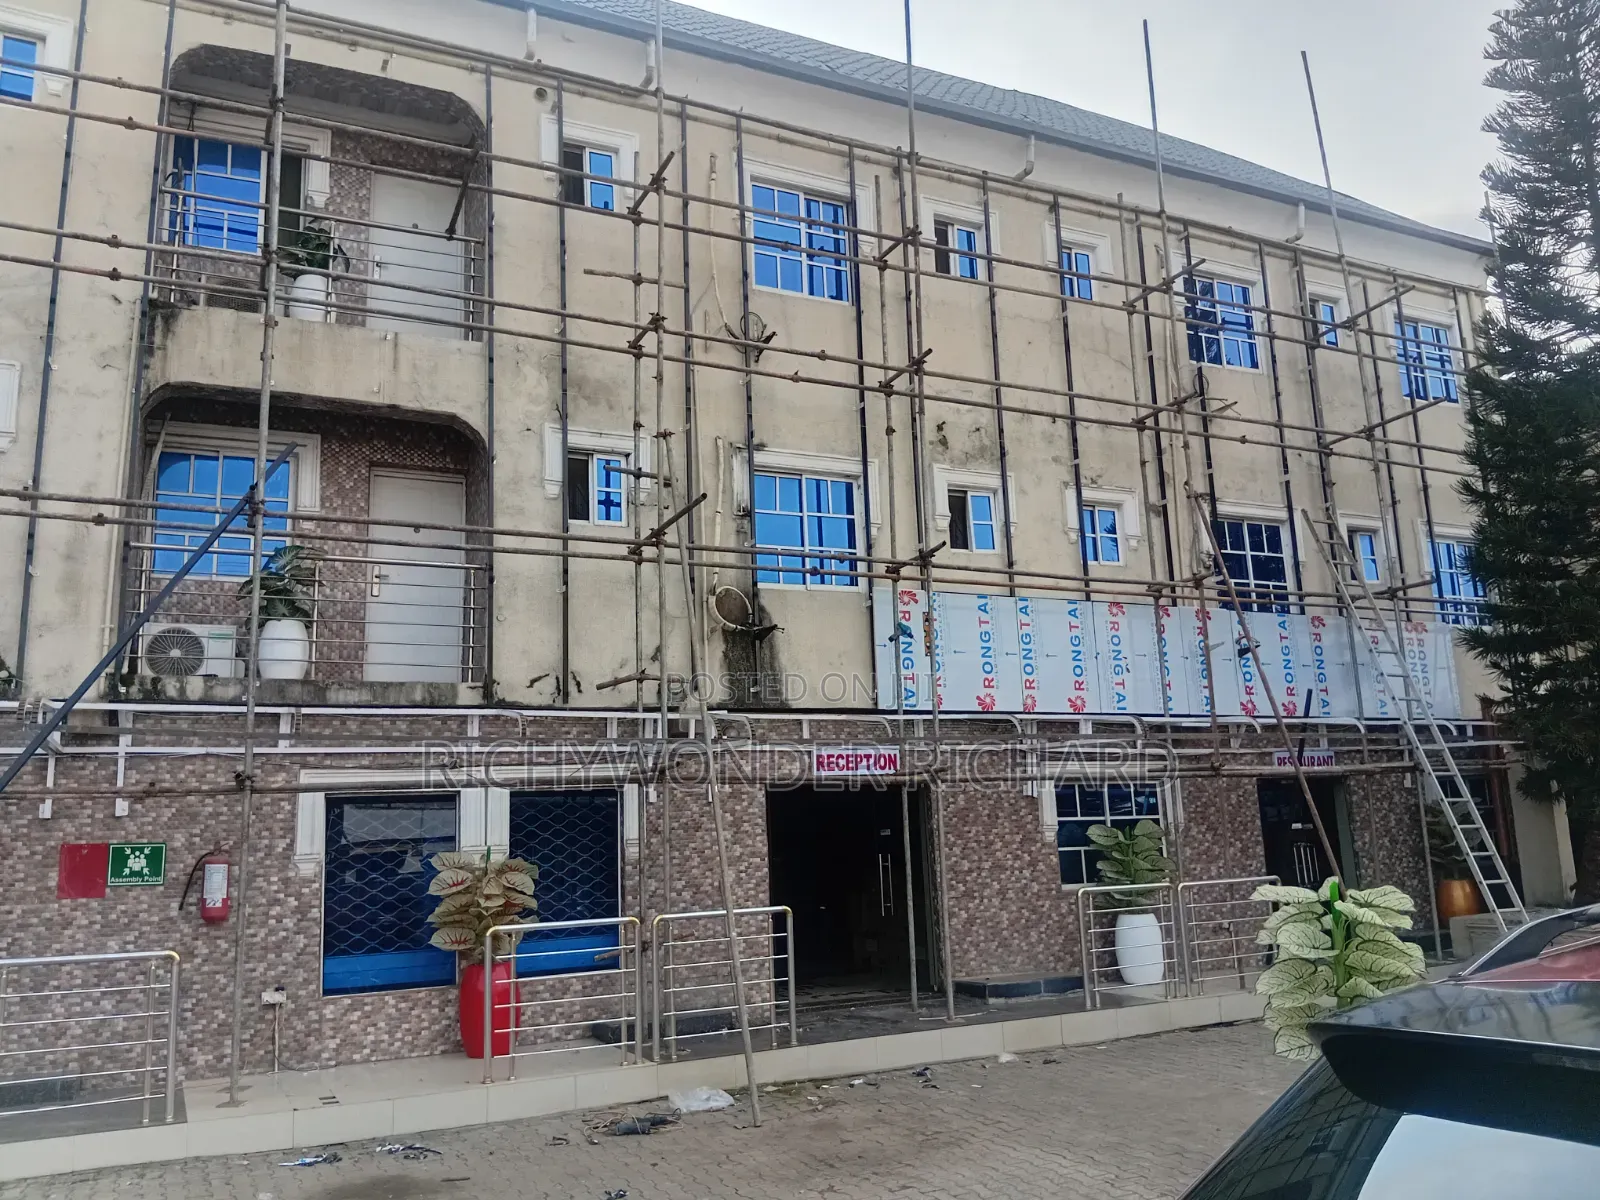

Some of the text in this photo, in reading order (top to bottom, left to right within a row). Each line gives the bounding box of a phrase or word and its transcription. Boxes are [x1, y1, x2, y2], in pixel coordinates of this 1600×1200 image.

[899, 610, 916, 708] RNGTAI
[977, 595, 994, 688] RONGTAI
[1018, 597, 1035, 690] RONGTAI
[1067, 601, 1085, 691] RONGTAI
[1109, 621, 1127, 711] RONGTAI
[1277, 613, 1296, 697] RONGTAI
[1312, 632, 1331, 715] RONGTAI
[815, 753, 898, 772] RECEPTION
[110, 876, 143, 884] Assembly
